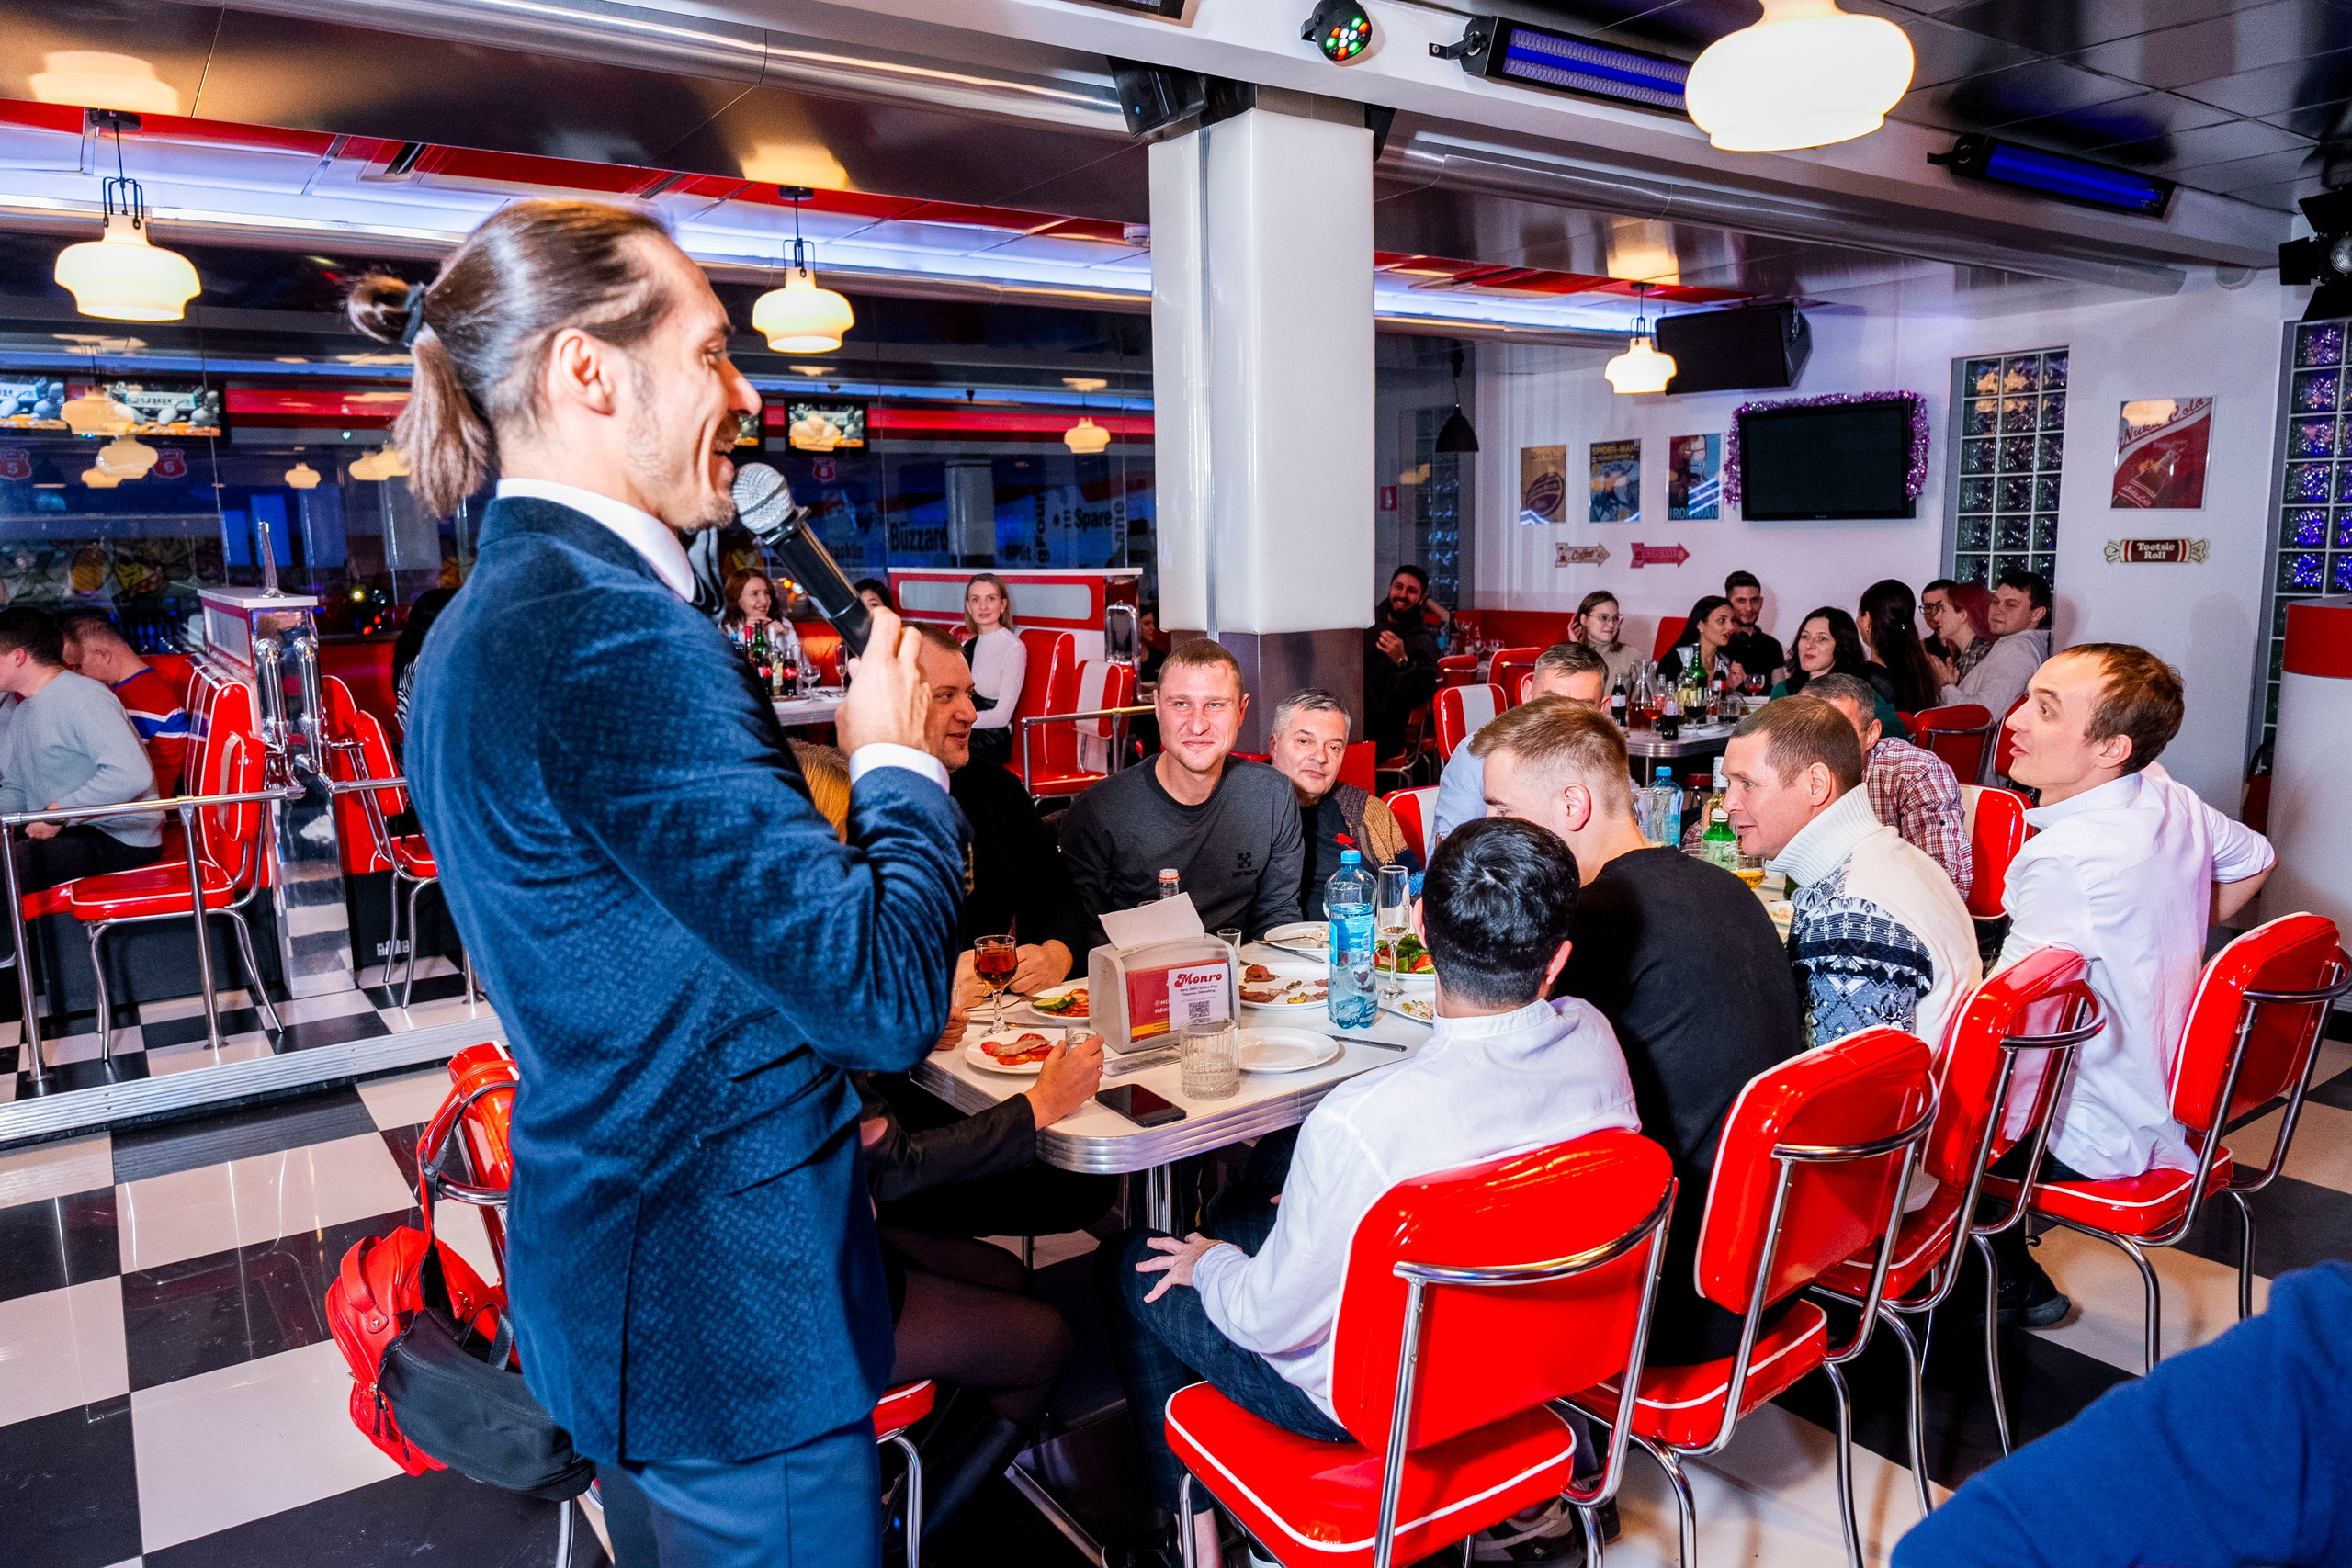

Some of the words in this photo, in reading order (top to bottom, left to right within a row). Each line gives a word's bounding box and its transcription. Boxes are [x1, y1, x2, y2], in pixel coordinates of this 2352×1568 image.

[2169, 398, 2204, 423] Cola
[1075, 507, 1112, 533] Spare
[2136, 542, 2175, 552] Tootsie
[2143, 551, 2165, 559] Roll
[1174, 973, 1223, 988] Monro
